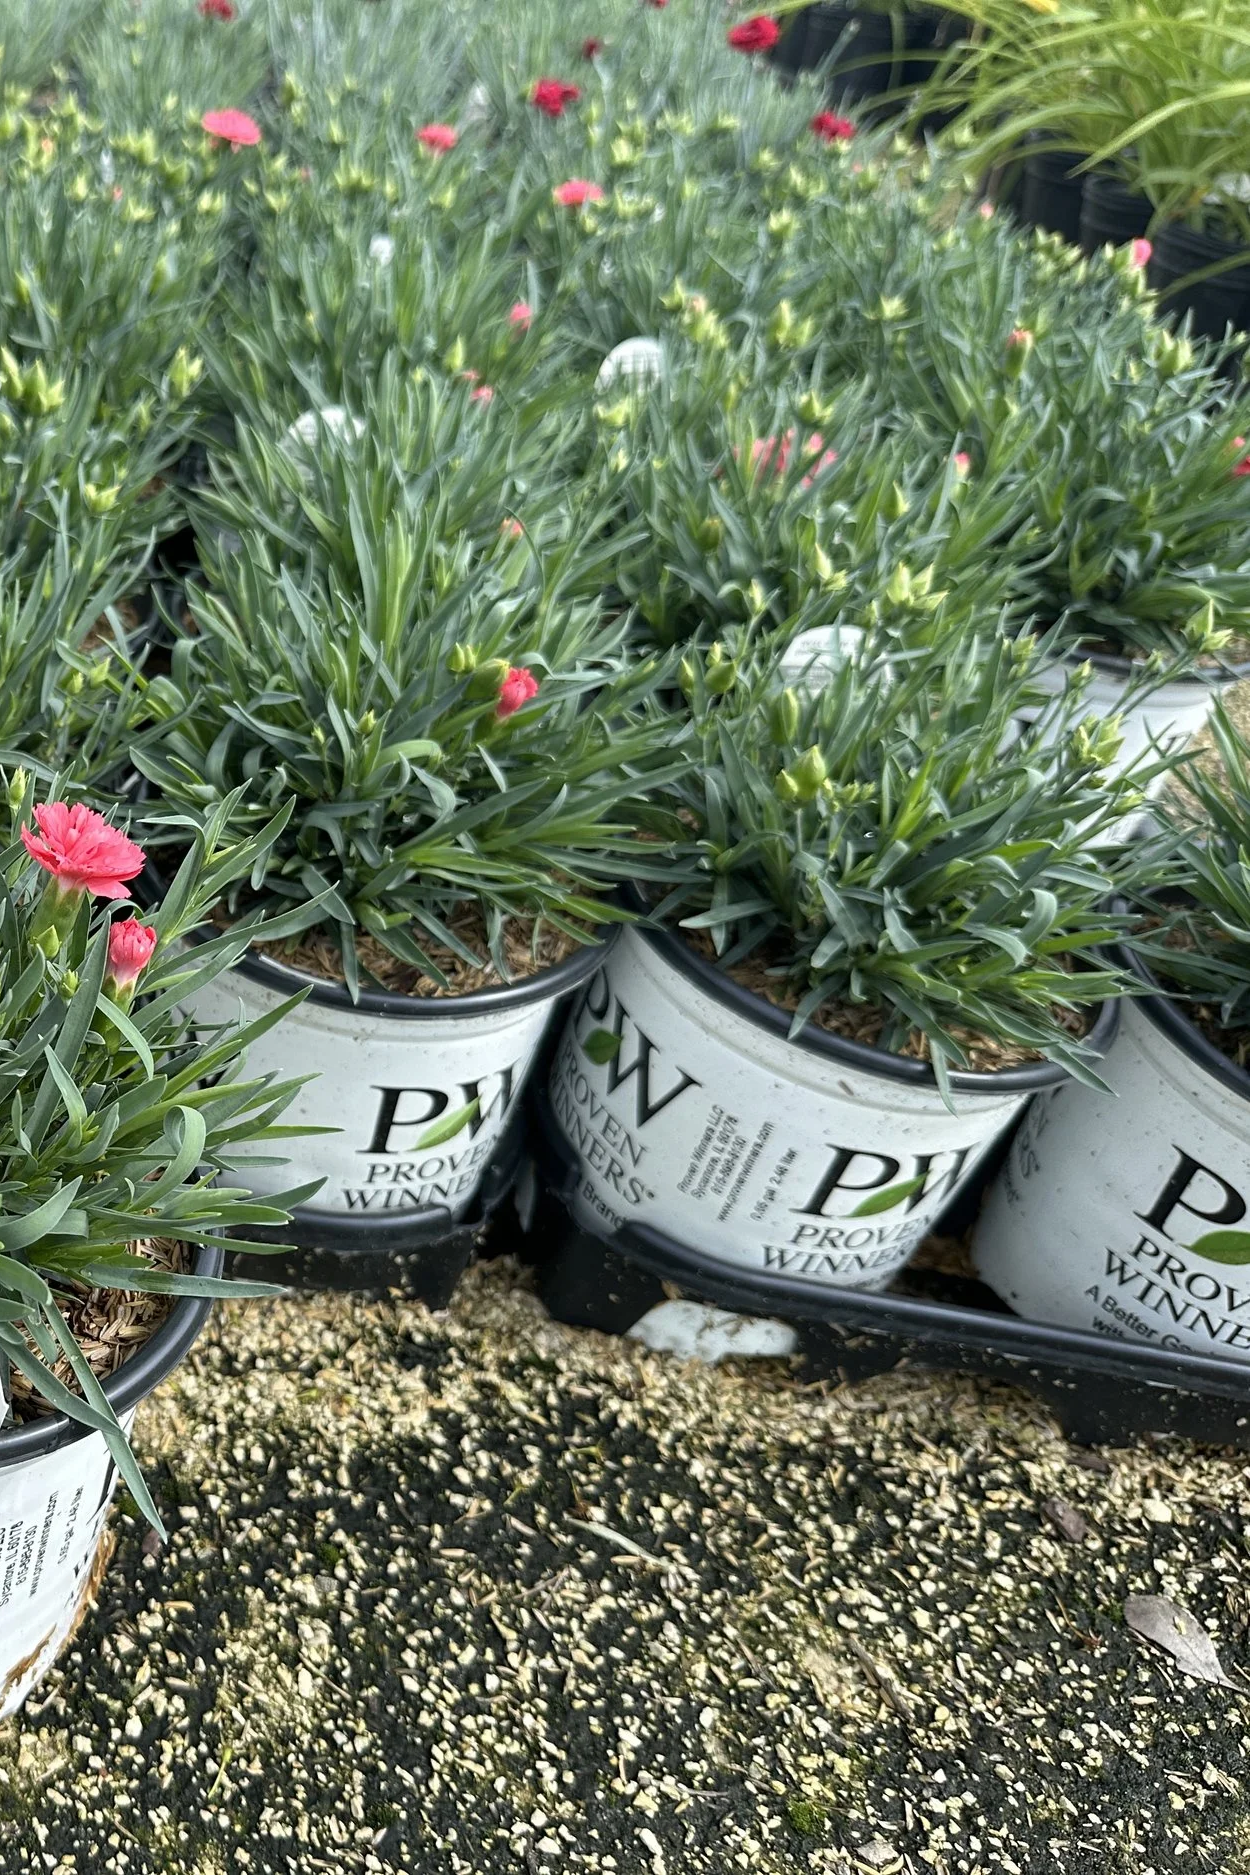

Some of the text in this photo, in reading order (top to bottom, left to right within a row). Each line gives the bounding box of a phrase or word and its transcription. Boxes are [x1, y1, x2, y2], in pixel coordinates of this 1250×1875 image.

[561, 1039, 648, 1169] PROVEN
[676, 1105, 724, 1193] Proven Winners LLC
[716, 1121, 775, 1222] www.provenwinners.com
[1084, 1285, 1158, 1338] A Better
[1105, 1246, 1250, 1349] WINNE
[1129, 1233, 1250, 1312] PROV
[7, 1520, 24, 1551] 60178
[15, 1525, 38, 1586] 815-895-8130
[29, 1490, 59, 1598] www.provenwinners.com
